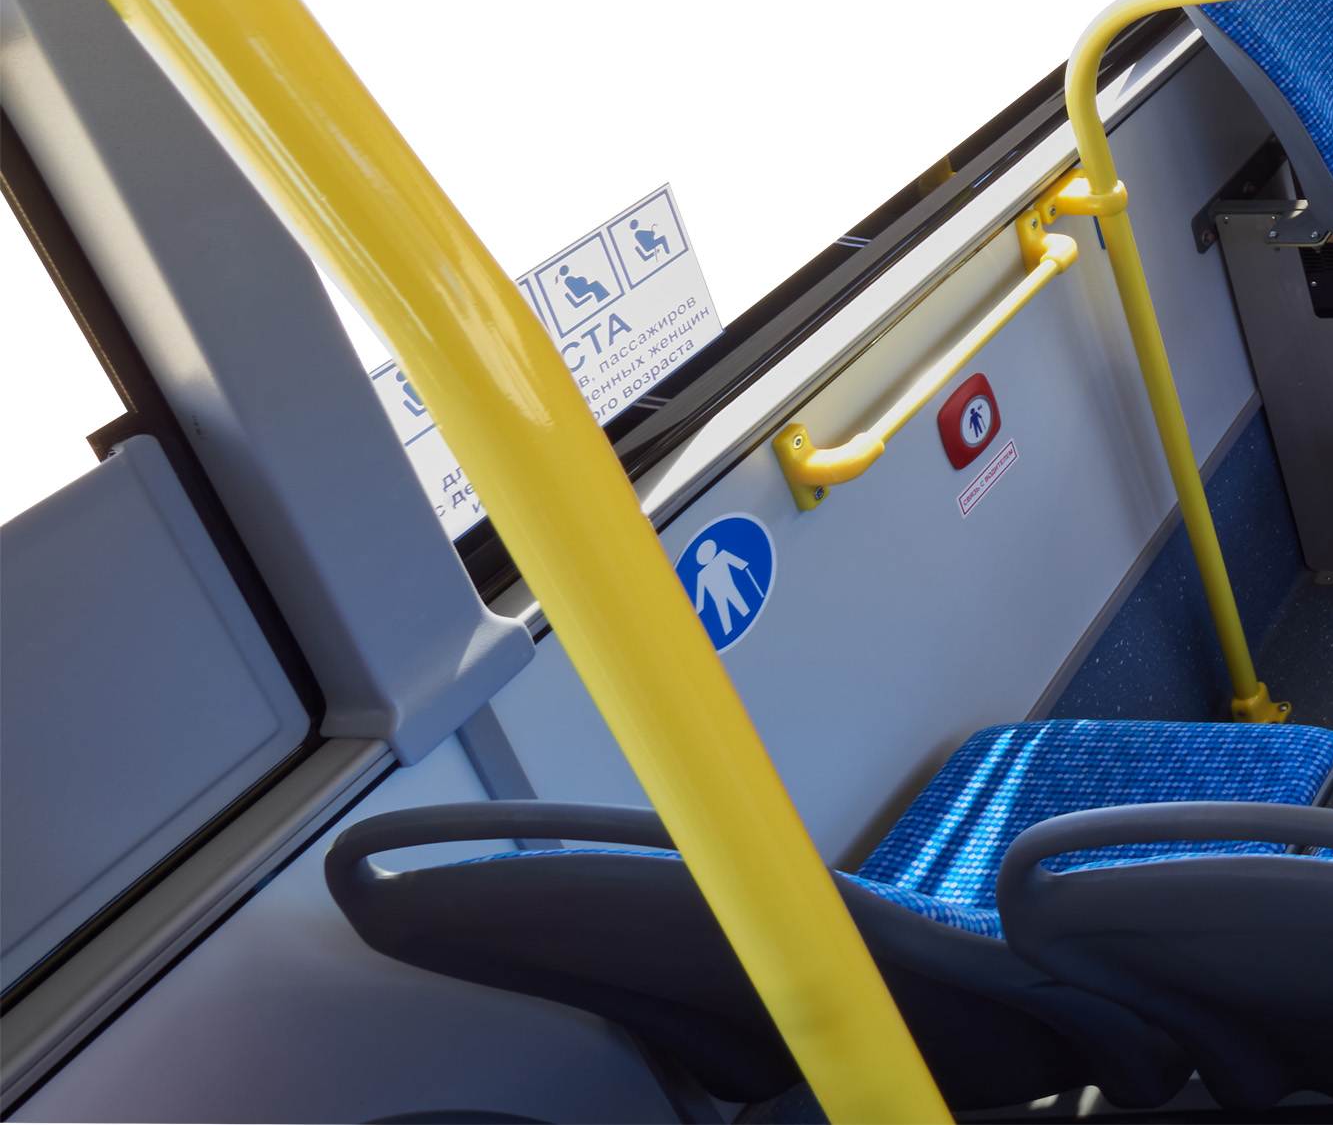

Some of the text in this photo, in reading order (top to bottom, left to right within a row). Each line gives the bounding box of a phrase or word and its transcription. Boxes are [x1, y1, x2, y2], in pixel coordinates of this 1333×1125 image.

[561, 312, 632, 372] СТА
[599, 297, 696, 373] пассажиров
[648, 307, 709, 358] женщин
[622, 339, 694, 398] возраста
[963, 487, 981, 506] СВЯЗЬ
[984, 448, 1014, 483] ВОДИТЕЛЕМ
